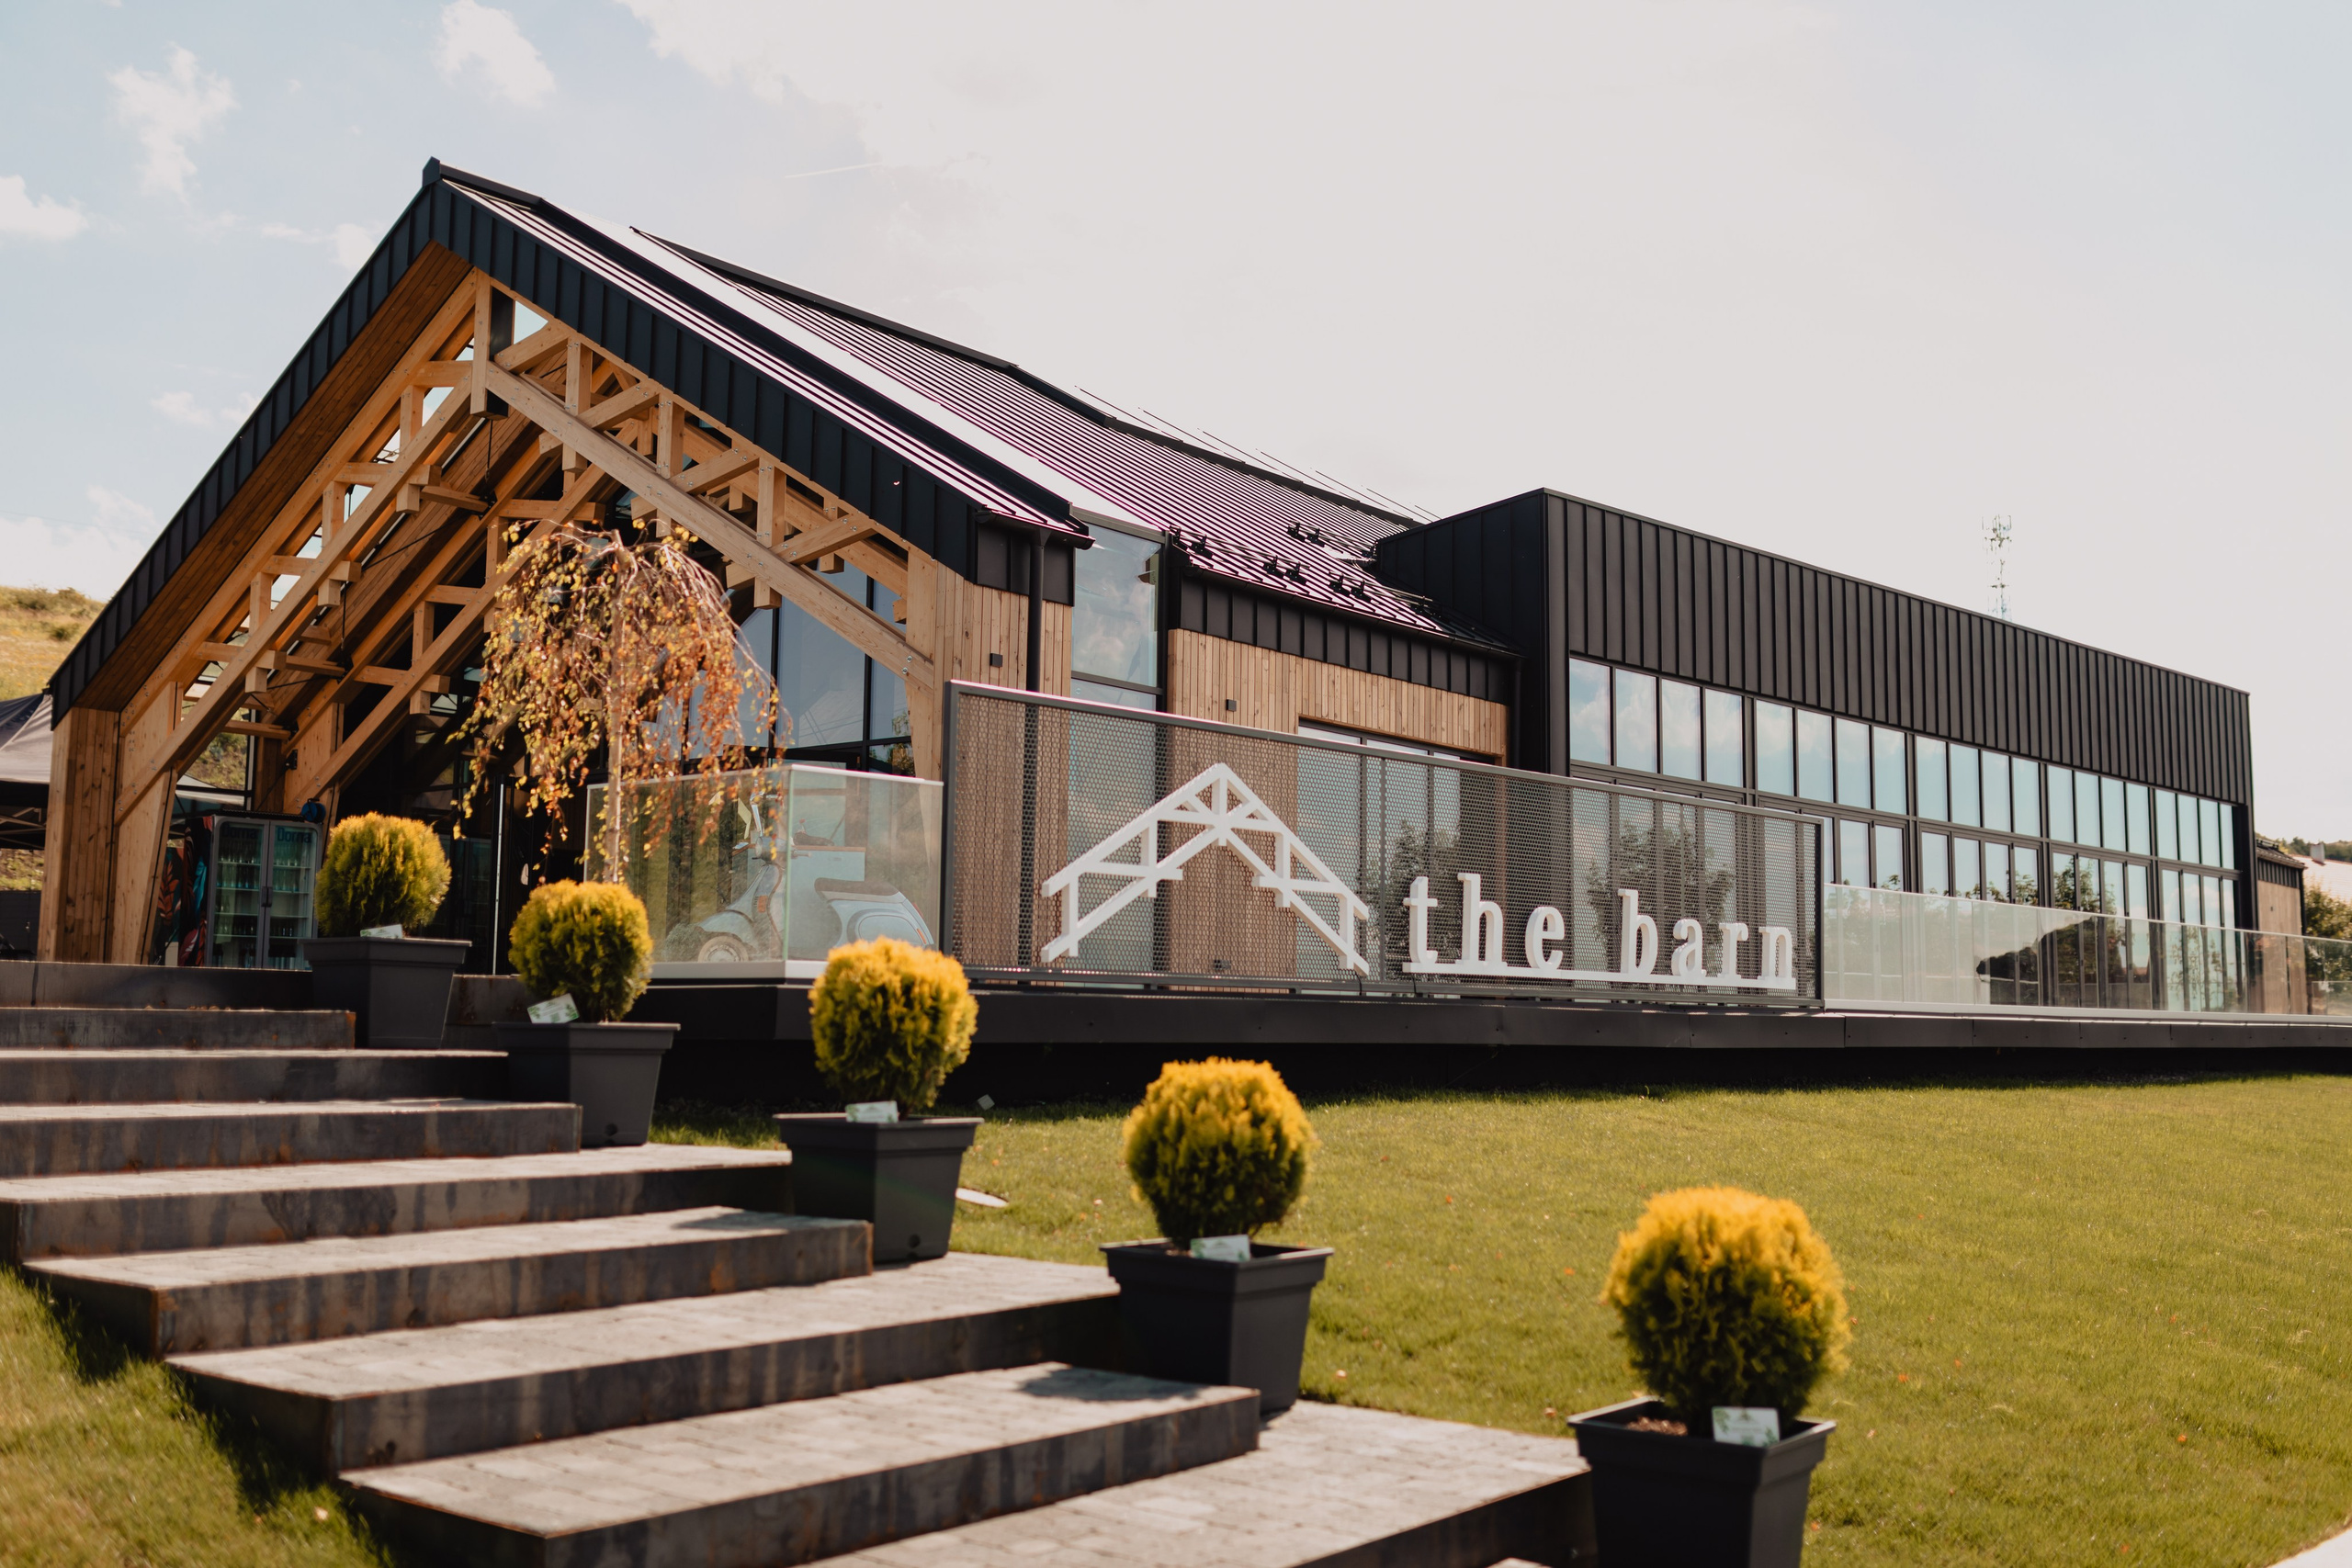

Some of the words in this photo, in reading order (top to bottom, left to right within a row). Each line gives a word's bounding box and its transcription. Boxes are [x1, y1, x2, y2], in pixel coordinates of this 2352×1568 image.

[277, 827, 312, 843] Dorna
[1403, 873, 1565, 970] the
[1618, 888, 1792, 979] barn
